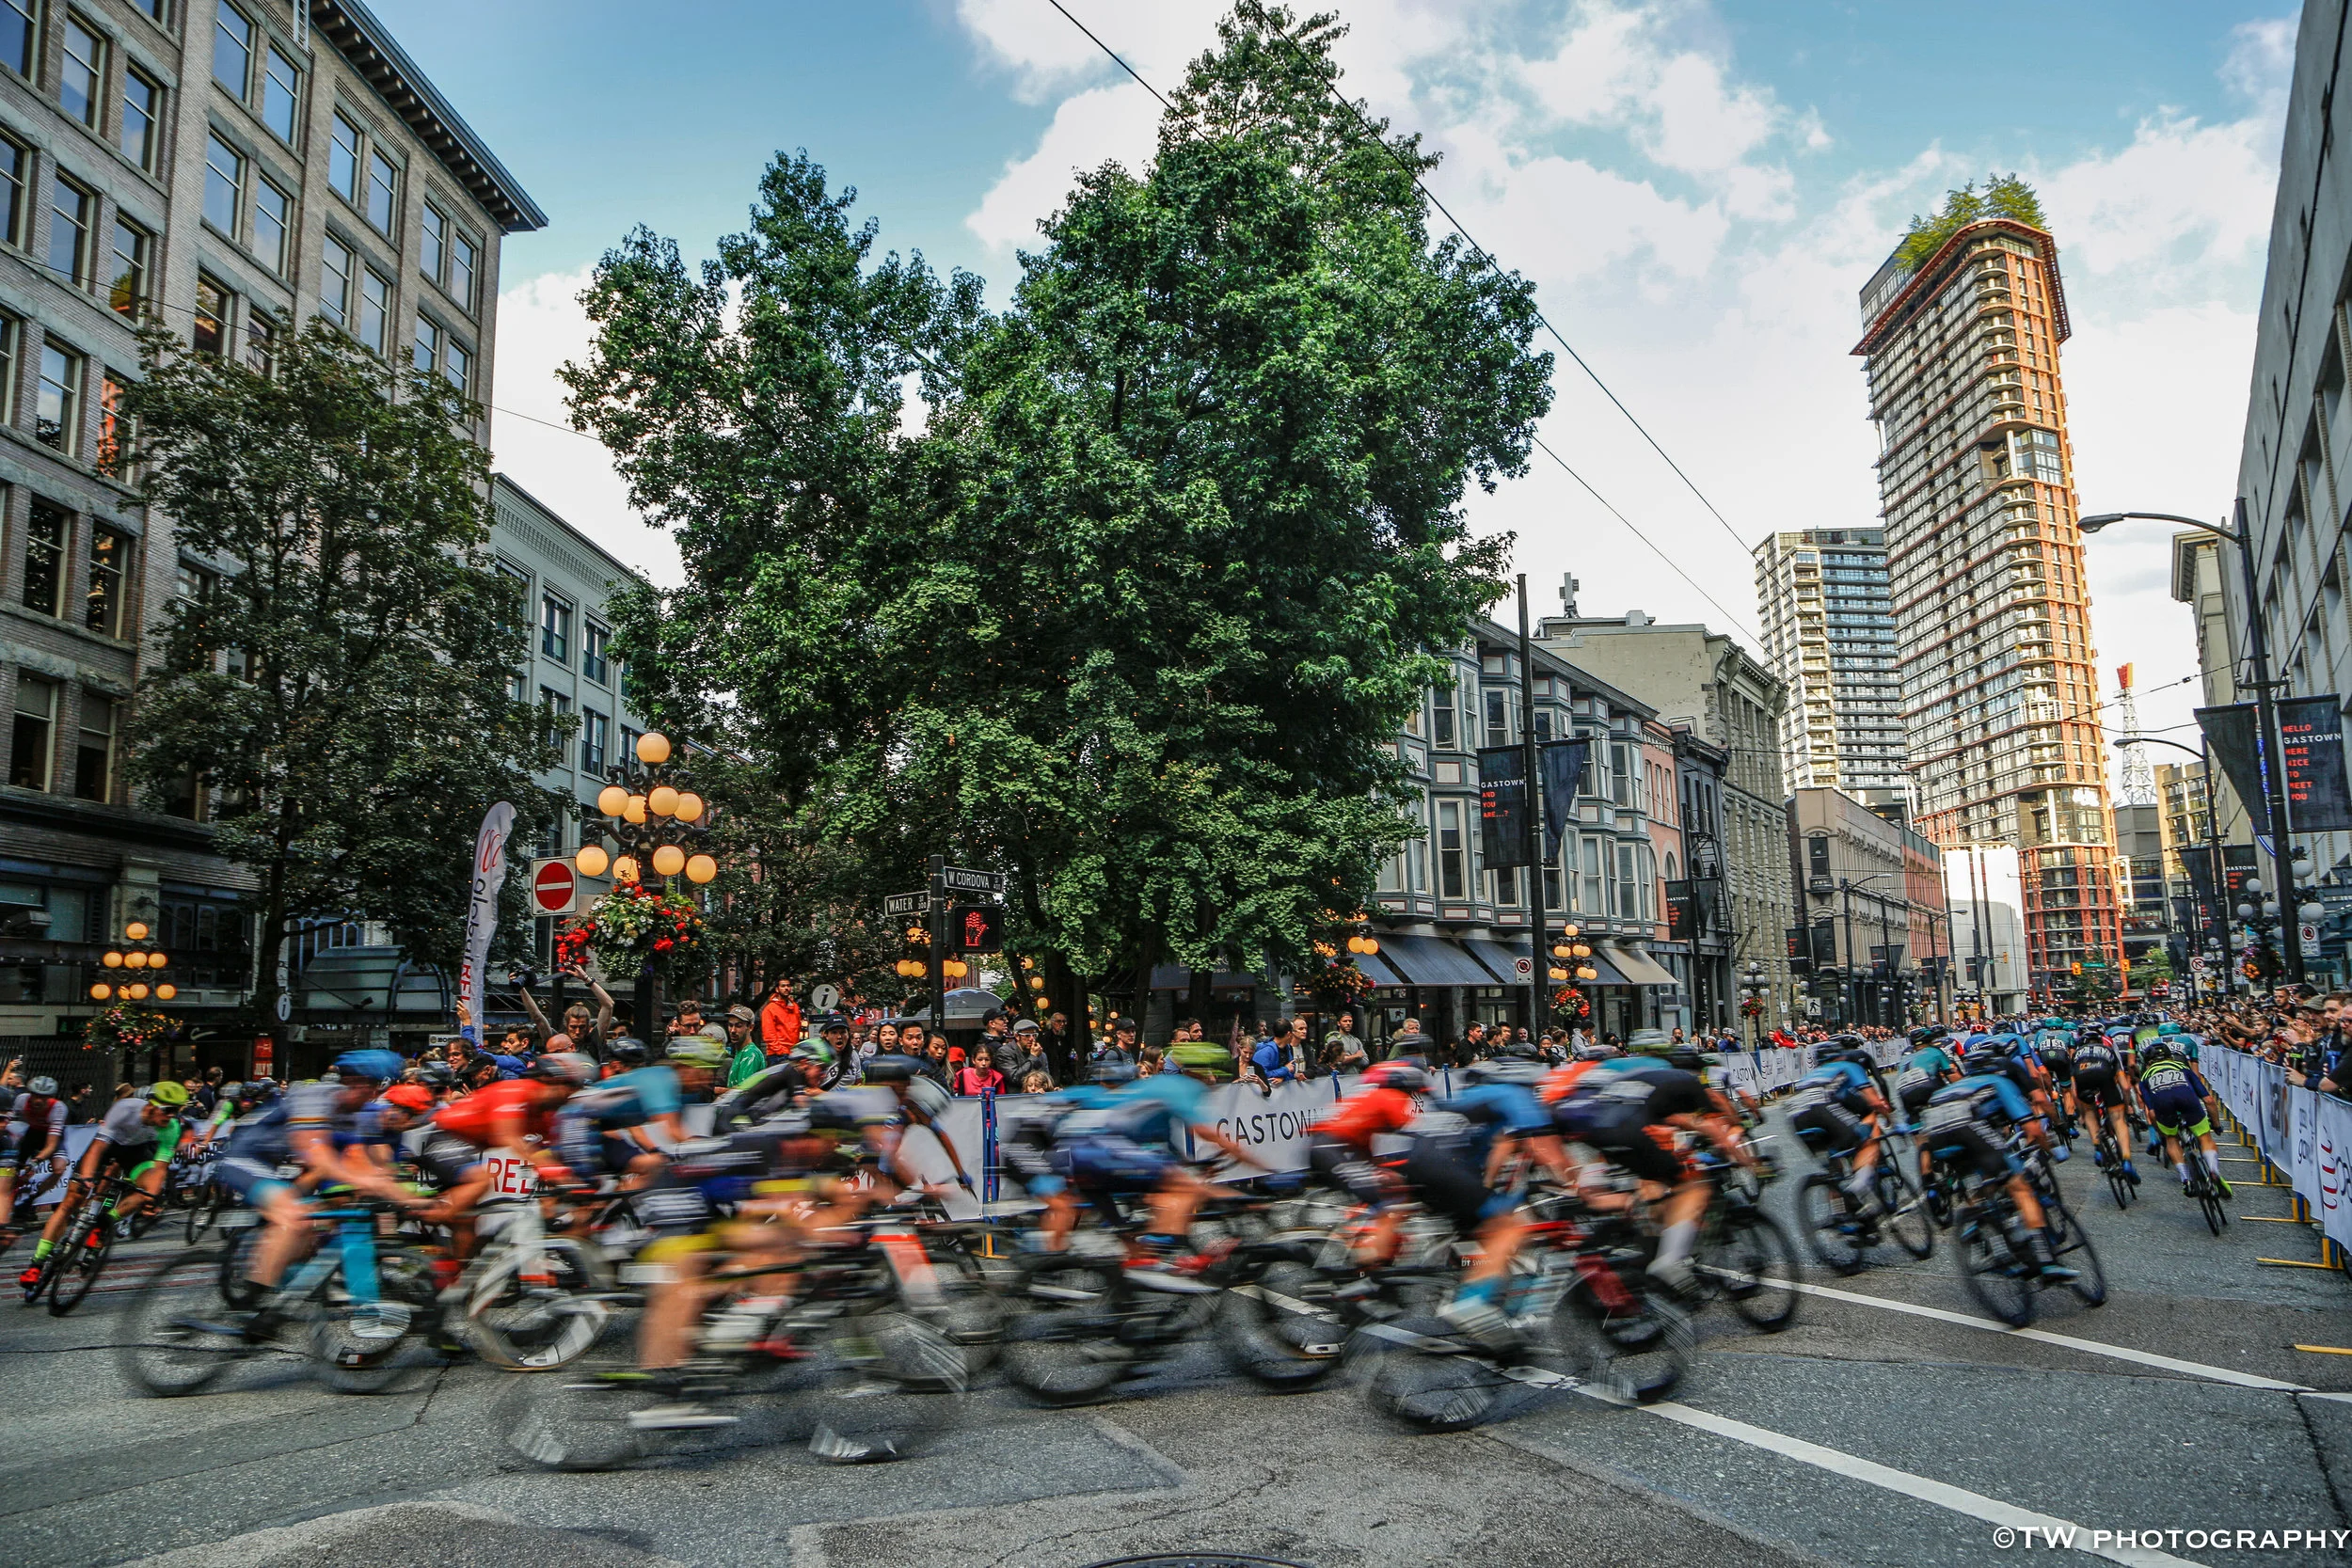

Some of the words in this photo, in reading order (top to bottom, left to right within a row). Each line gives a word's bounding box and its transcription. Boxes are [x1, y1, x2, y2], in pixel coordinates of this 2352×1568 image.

[2282, 723, 2312, 733] HELLO
[2283, 733, 2343, 745] GASTOWN
[2287, 758, 2310, 767] NICE
[2288, 770, 2300, 779] TO
[1480, 778, 1525, 789] GASTOWN
[2289, 781, 2313, 789] MEET
[947, 871, 956, 884] W
[956, 872, 990, 889] CORDOVA
[889, 897, 914, 912] WATER
[2152, 1073, 2165, 1086] 22
[2169, 1071, 2183, 1082] 22
